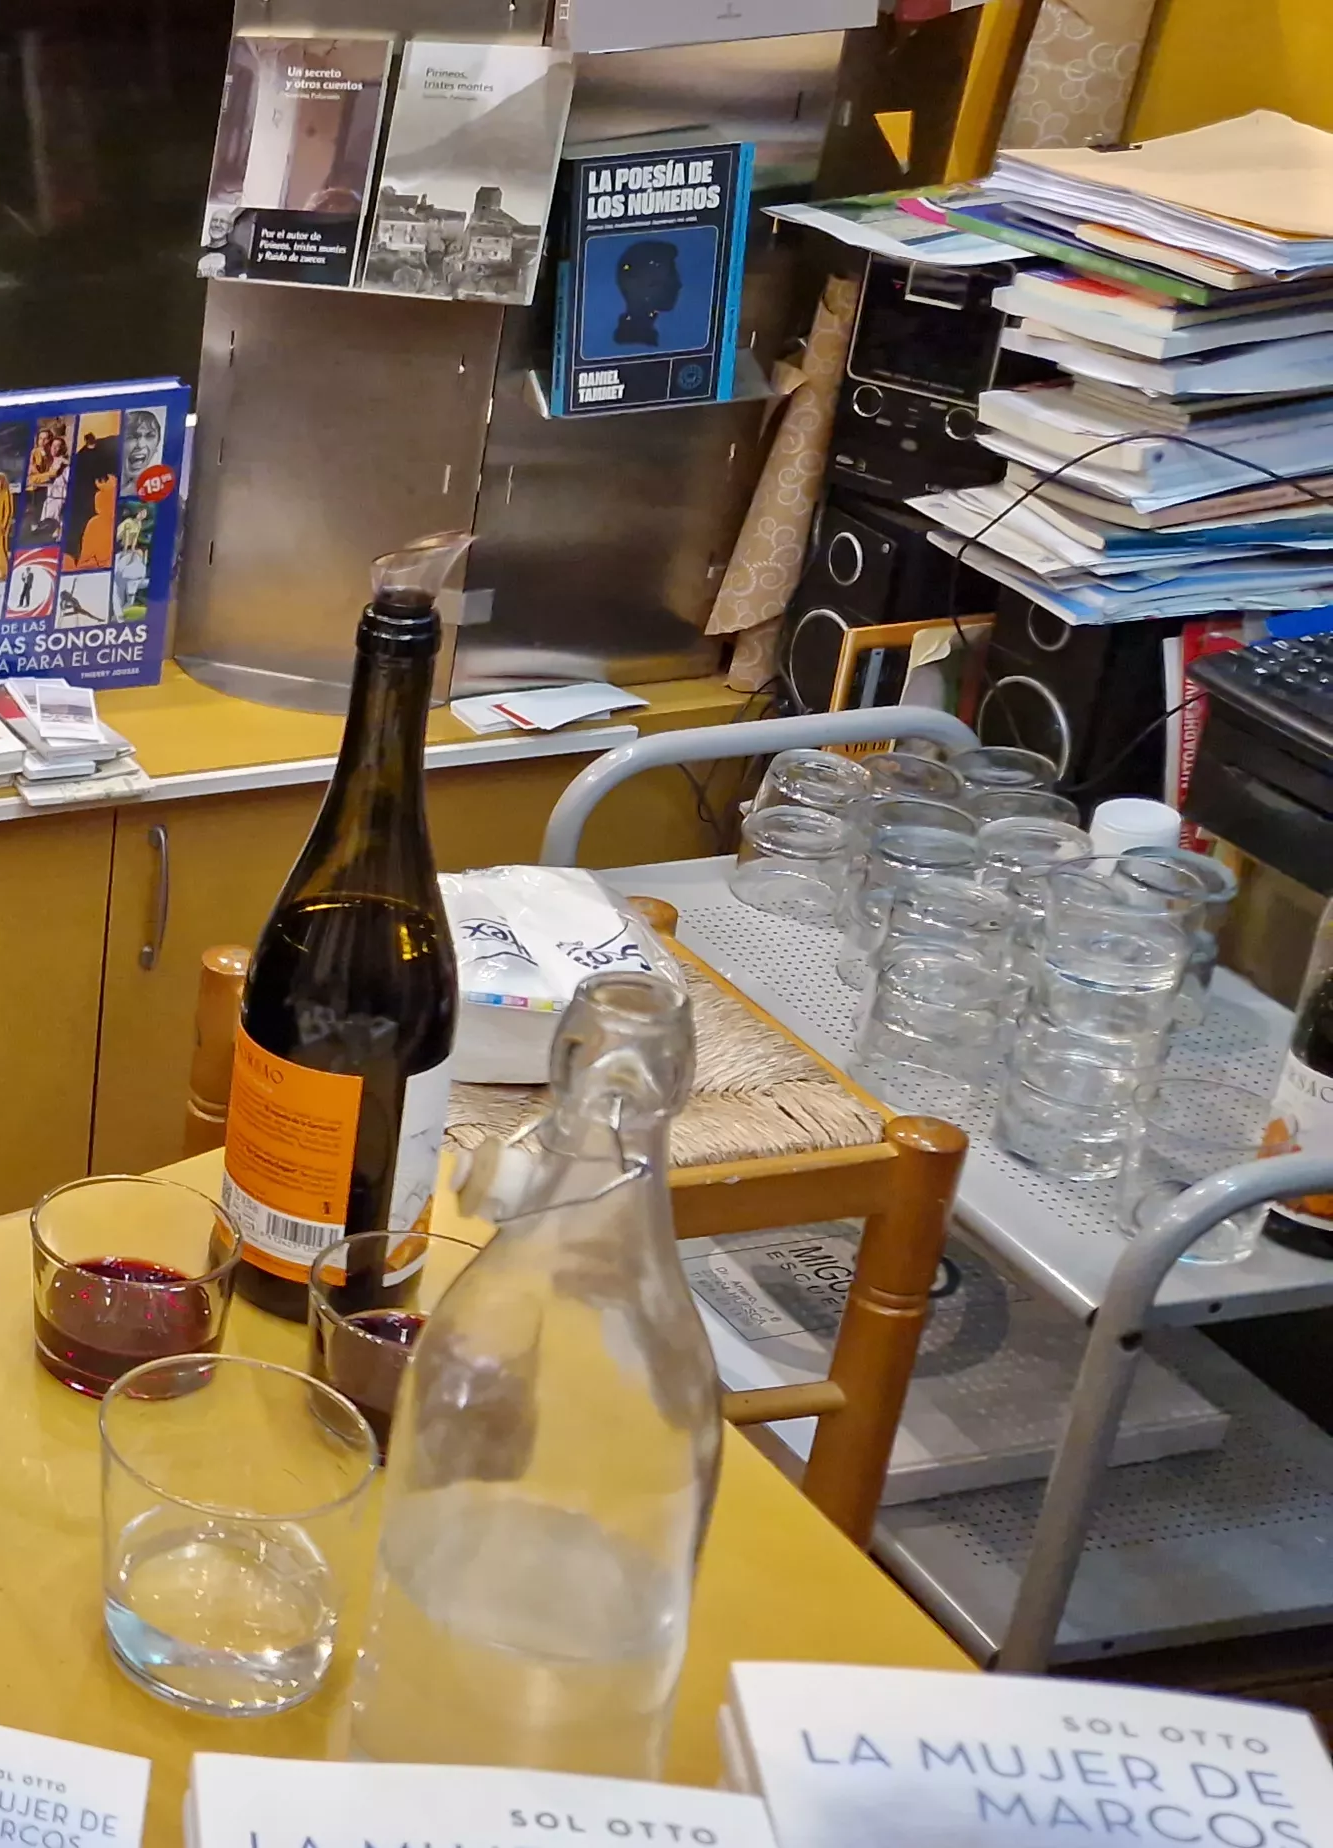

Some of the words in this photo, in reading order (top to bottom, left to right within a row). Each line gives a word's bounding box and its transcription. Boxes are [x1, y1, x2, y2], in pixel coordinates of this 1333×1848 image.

[285, 80, 293, 91] y
[294, 79, 320, 89] otros
[322, 80, 363, 91] cuentos
[287, 66, 302, 77] Un
[304, 68, 342, 78] secreto
[424, 80, 455, 90] tristes
[457, 82, 494, 92] montes
[588, 169, 612, 194] LA
[614, 159, 685, 192] POESÍA
[688, 160, 714, 185] DE
[586, 194, 626, 221] LOS
[627, 185, 721, 217] NÚMEROS
[261, 228, 275, 239] Por
[276, 229, 285, 239] el
[286, 231, 309, 240] autor
[310, 231, 322, 241] de
[257, 252, 264, 262] y
[288, 252, 299, 262] de
[579, 369, 620, 388] DANIEL
[578, 384, 626, 404] TAMMET
[1, 624, 18, 635] DE
[22, 620, 46, 632] LAS
[34, 624, 148, 652] SONORAS
[16, 656, 64, 673] PARA
[71, 651, 90, 667] EL
[96, 646, 144, 664] CINE
[789, 1246, 854, 1300] MIGU
[1062, 1715, 1140, 1739] SOL
[1159, 1723, 1270, 1756] OTTO
[800, 1728, 893, 1770] LA
[918, 1737, 1166, 1795] MUJER
[1189, 1760, 1297, 1812] DE
[23, 1775, 67, 1795] OTTO
[80, 1809, 120, 1838] DE
[510, 1808, 589, 1834] SOL
[607, 1818, 719, 1846] OTTO
[976, 1787, 1317, 1848] MARCOS
